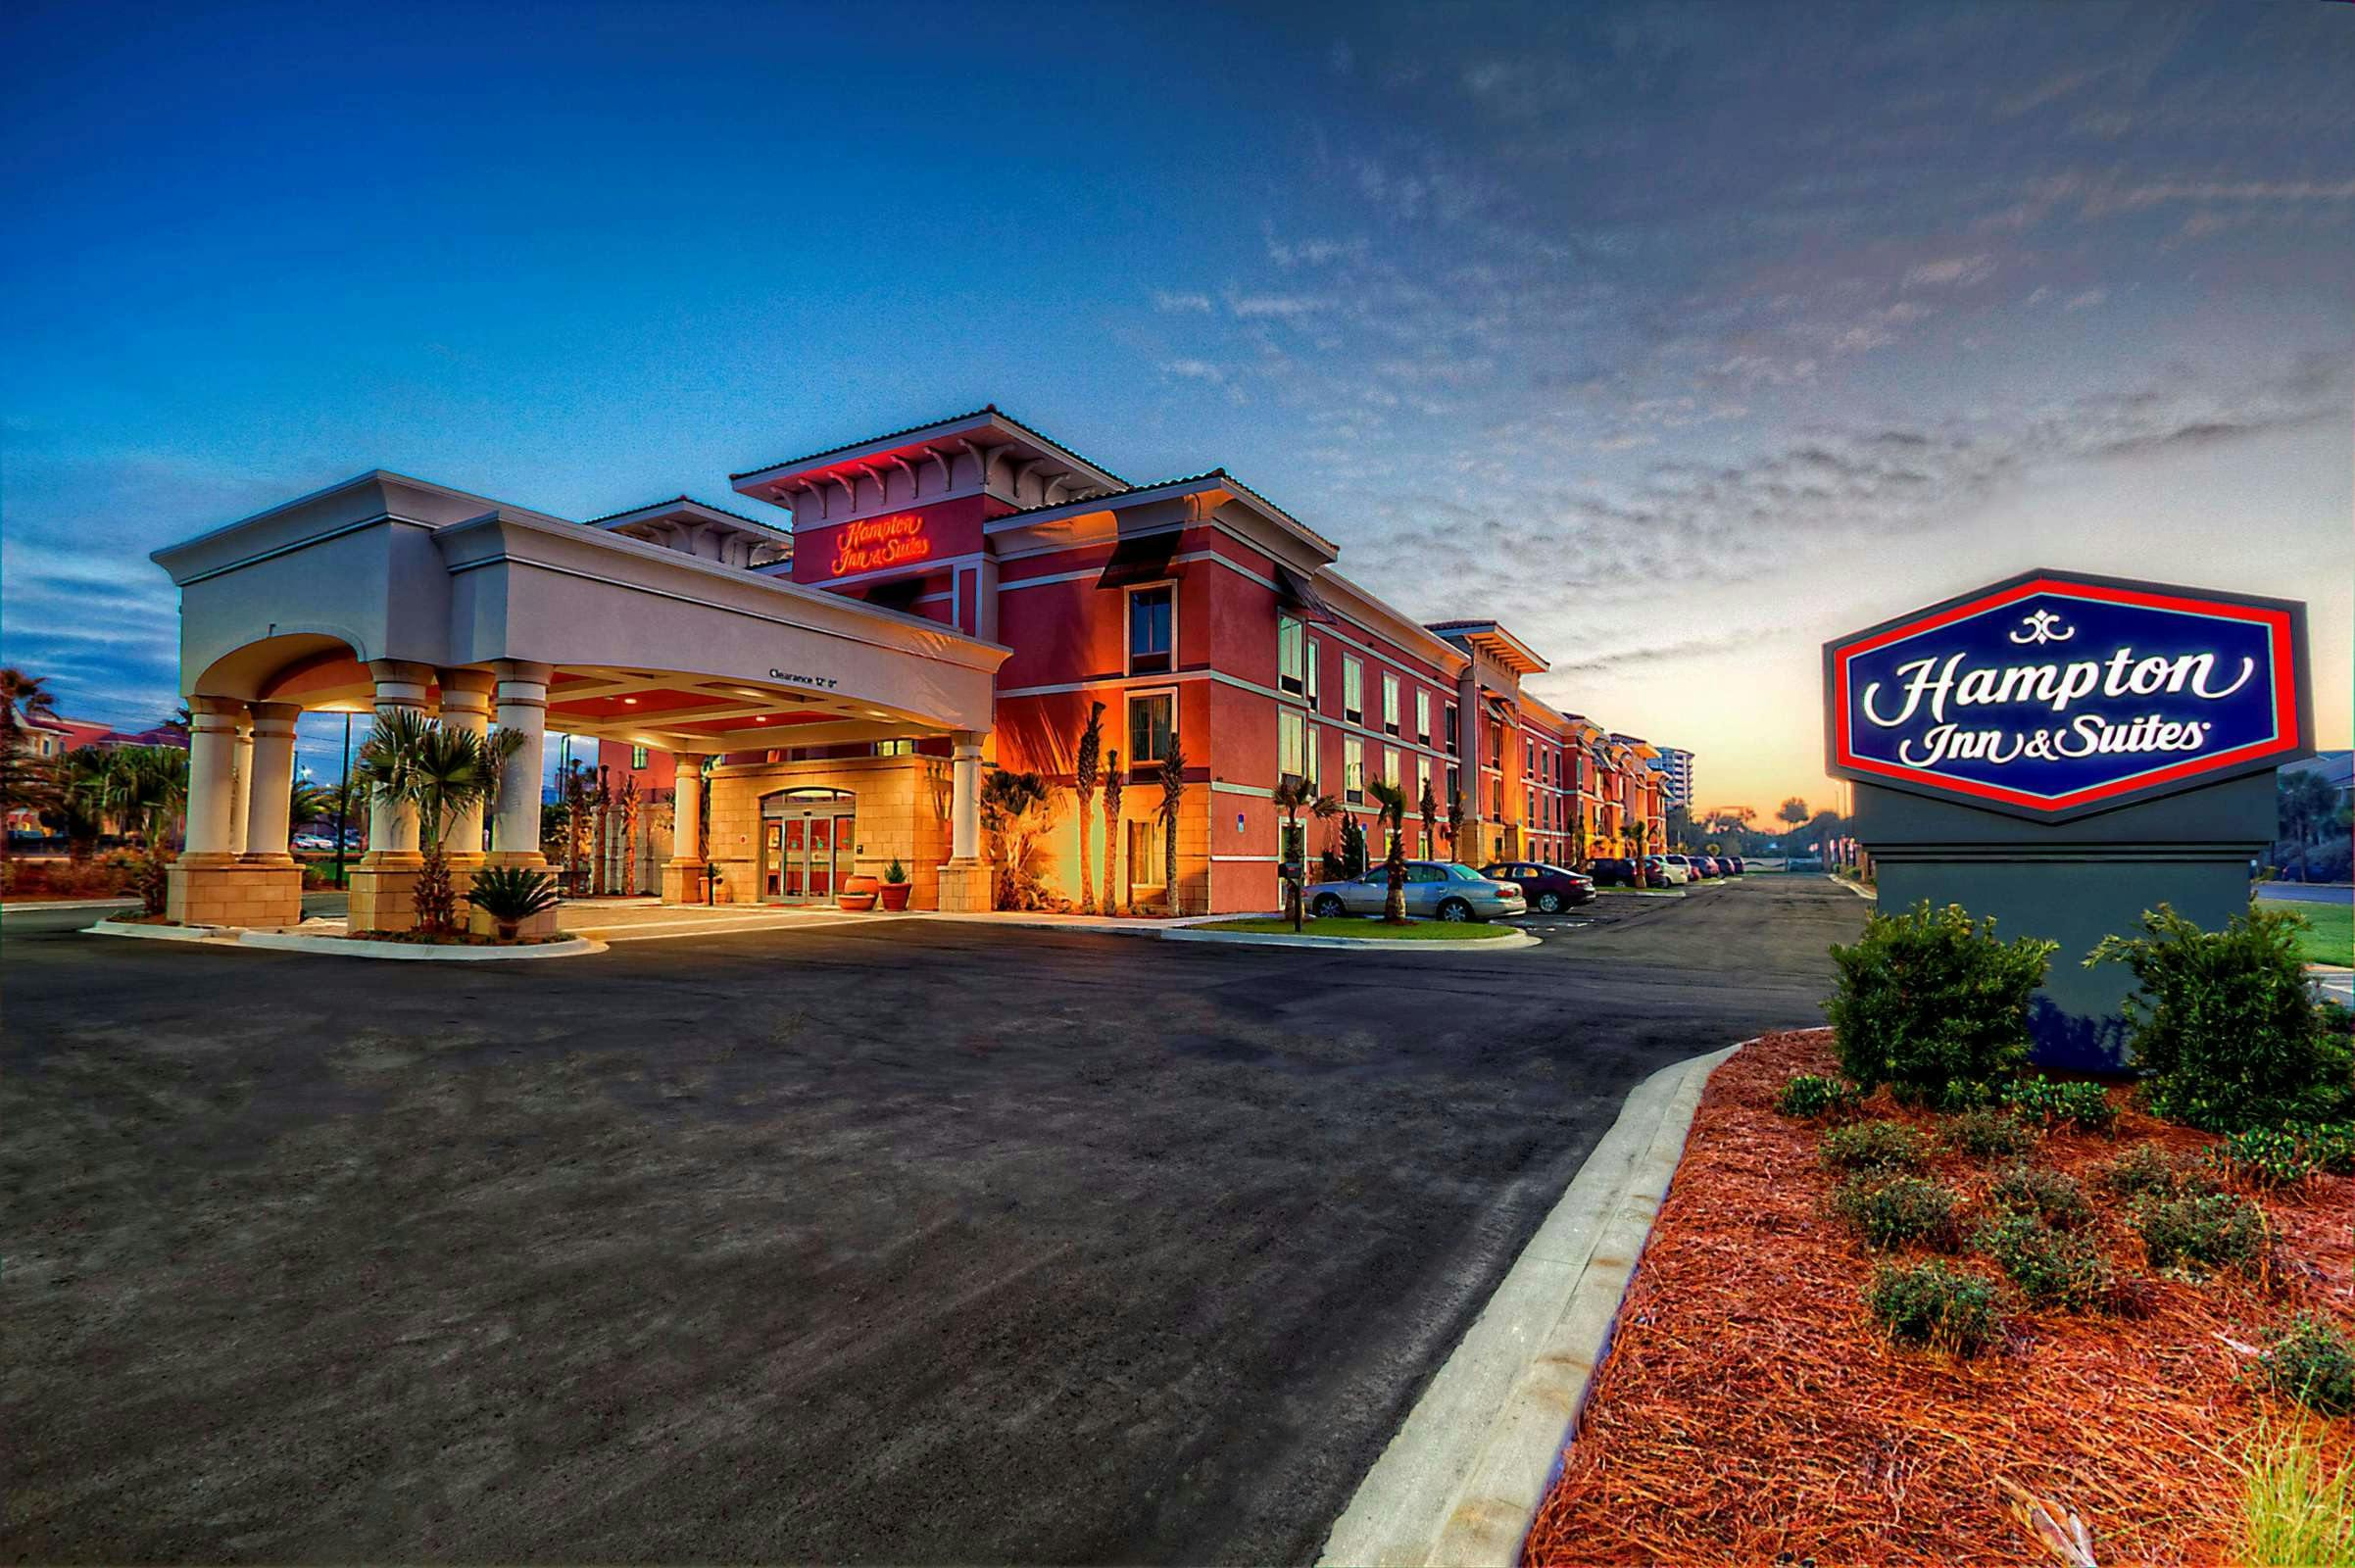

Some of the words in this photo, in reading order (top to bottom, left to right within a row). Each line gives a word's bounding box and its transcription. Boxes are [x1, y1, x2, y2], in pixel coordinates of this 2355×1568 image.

[837, 516, 924, 551] Hampton
[832, 548, 872, 575] Inn
[882, 537, 929, 563] Suites
[769, 668, 813, 684] Clearance
[1863, 647, 2254, 727] Hampton
[1898, 721, 2024, 767] Inn
[2024, 729, 2060, 761] &
[2053, 713, 2205, 758] Suites
